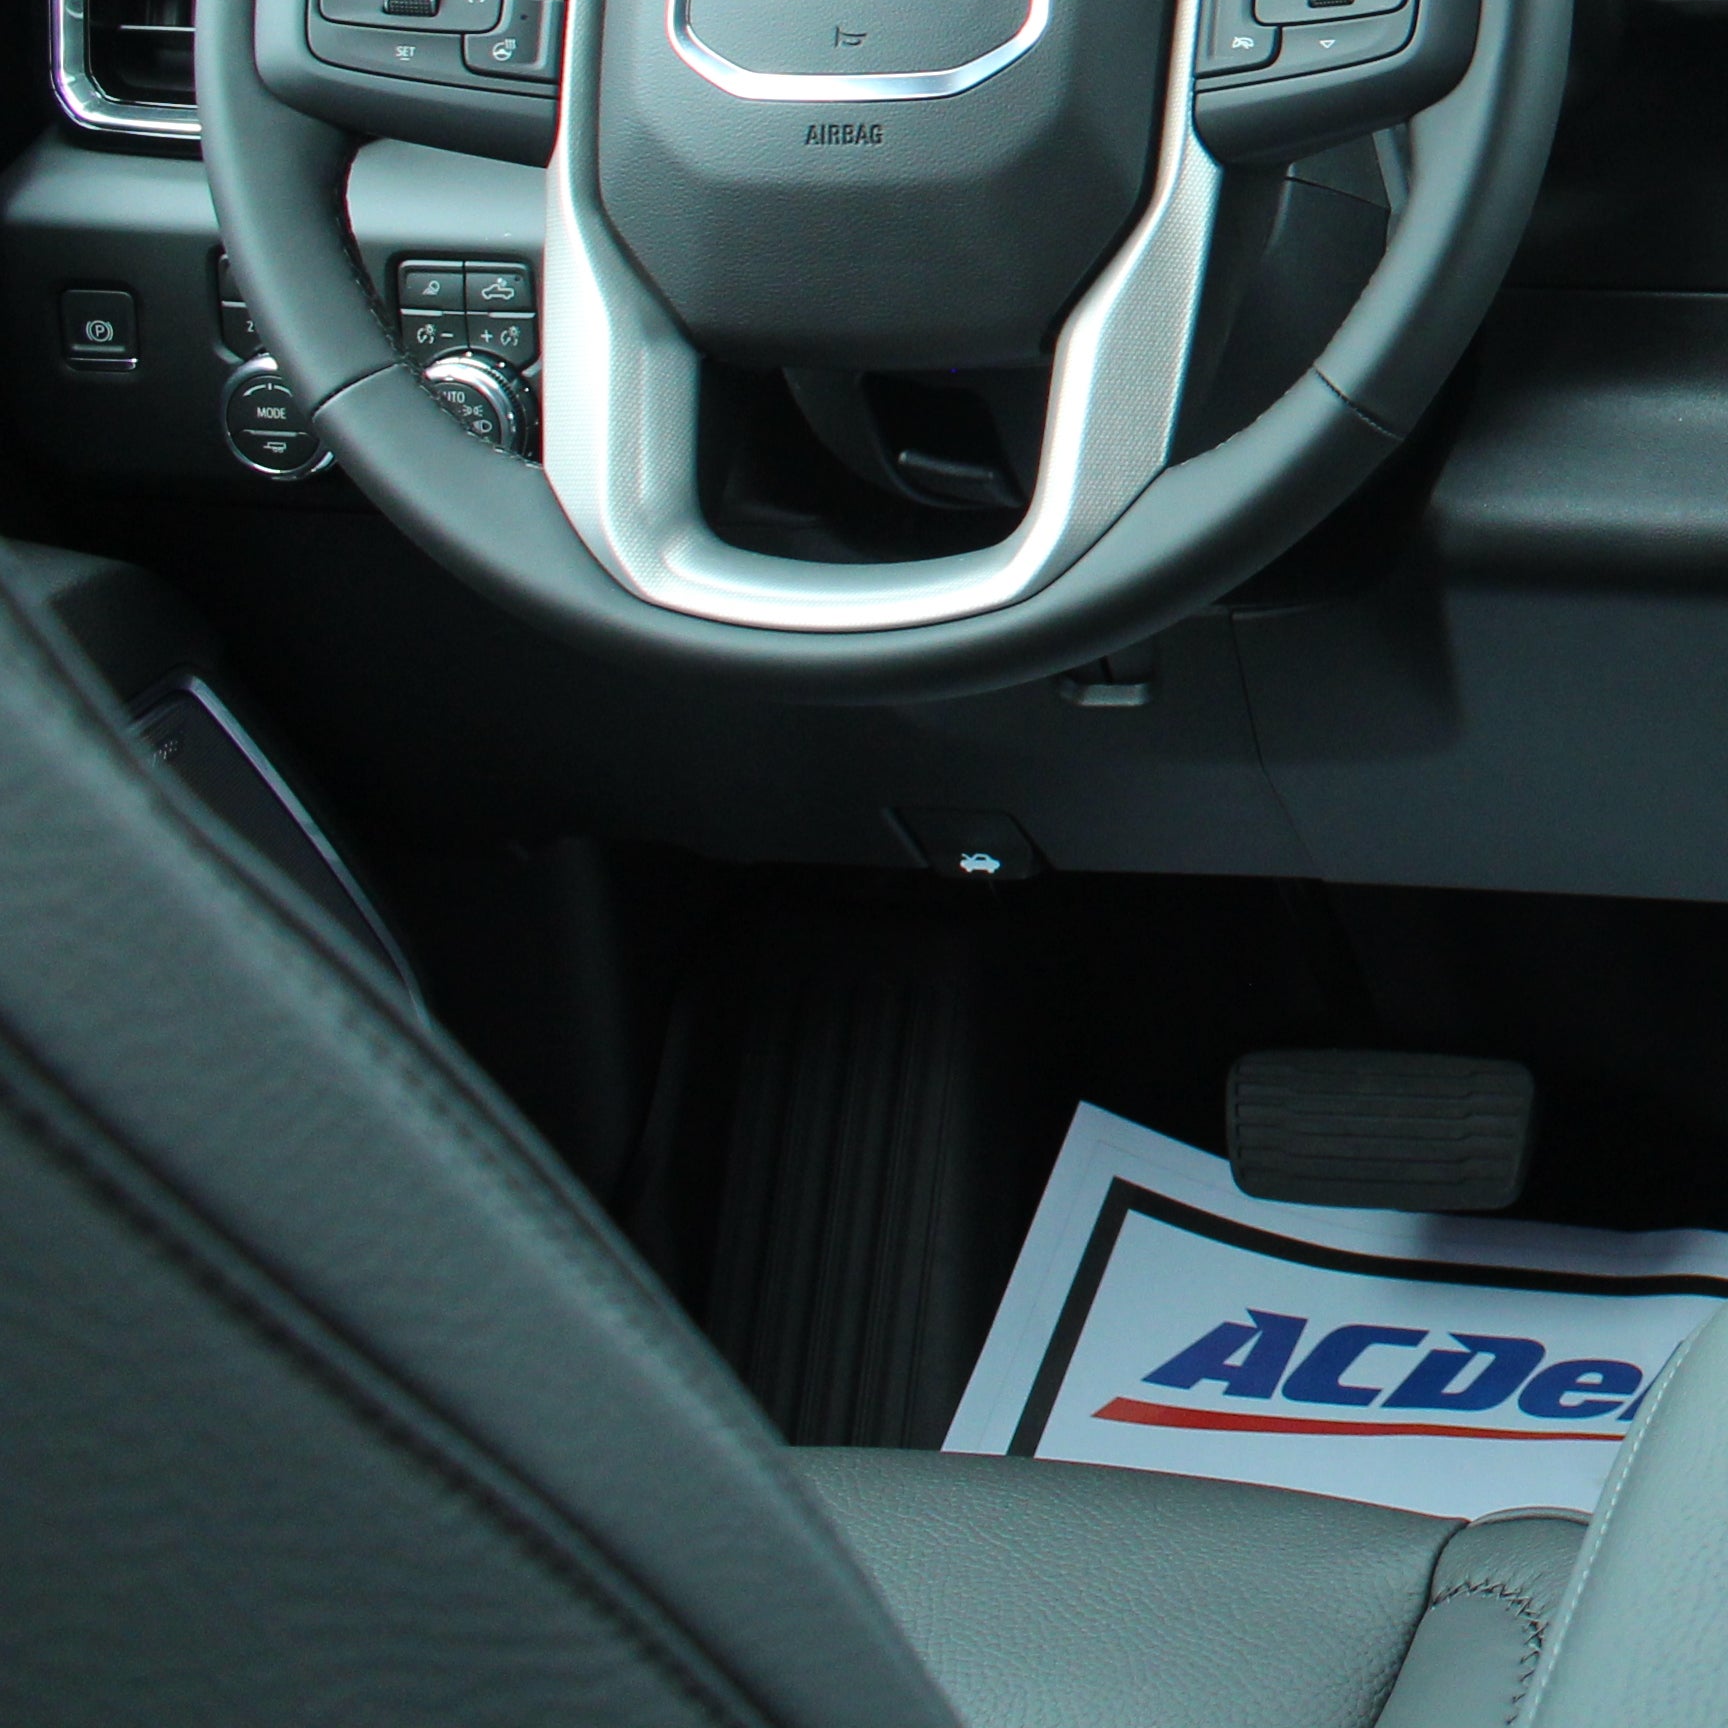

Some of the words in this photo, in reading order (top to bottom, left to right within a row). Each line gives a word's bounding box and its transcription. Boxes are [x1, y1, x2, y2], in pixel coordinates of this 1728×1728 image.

[395, 45, 417, 58] SET
[804, 124, 884, 146] AIRBAG
[256, 406, 287, 421] MODE
